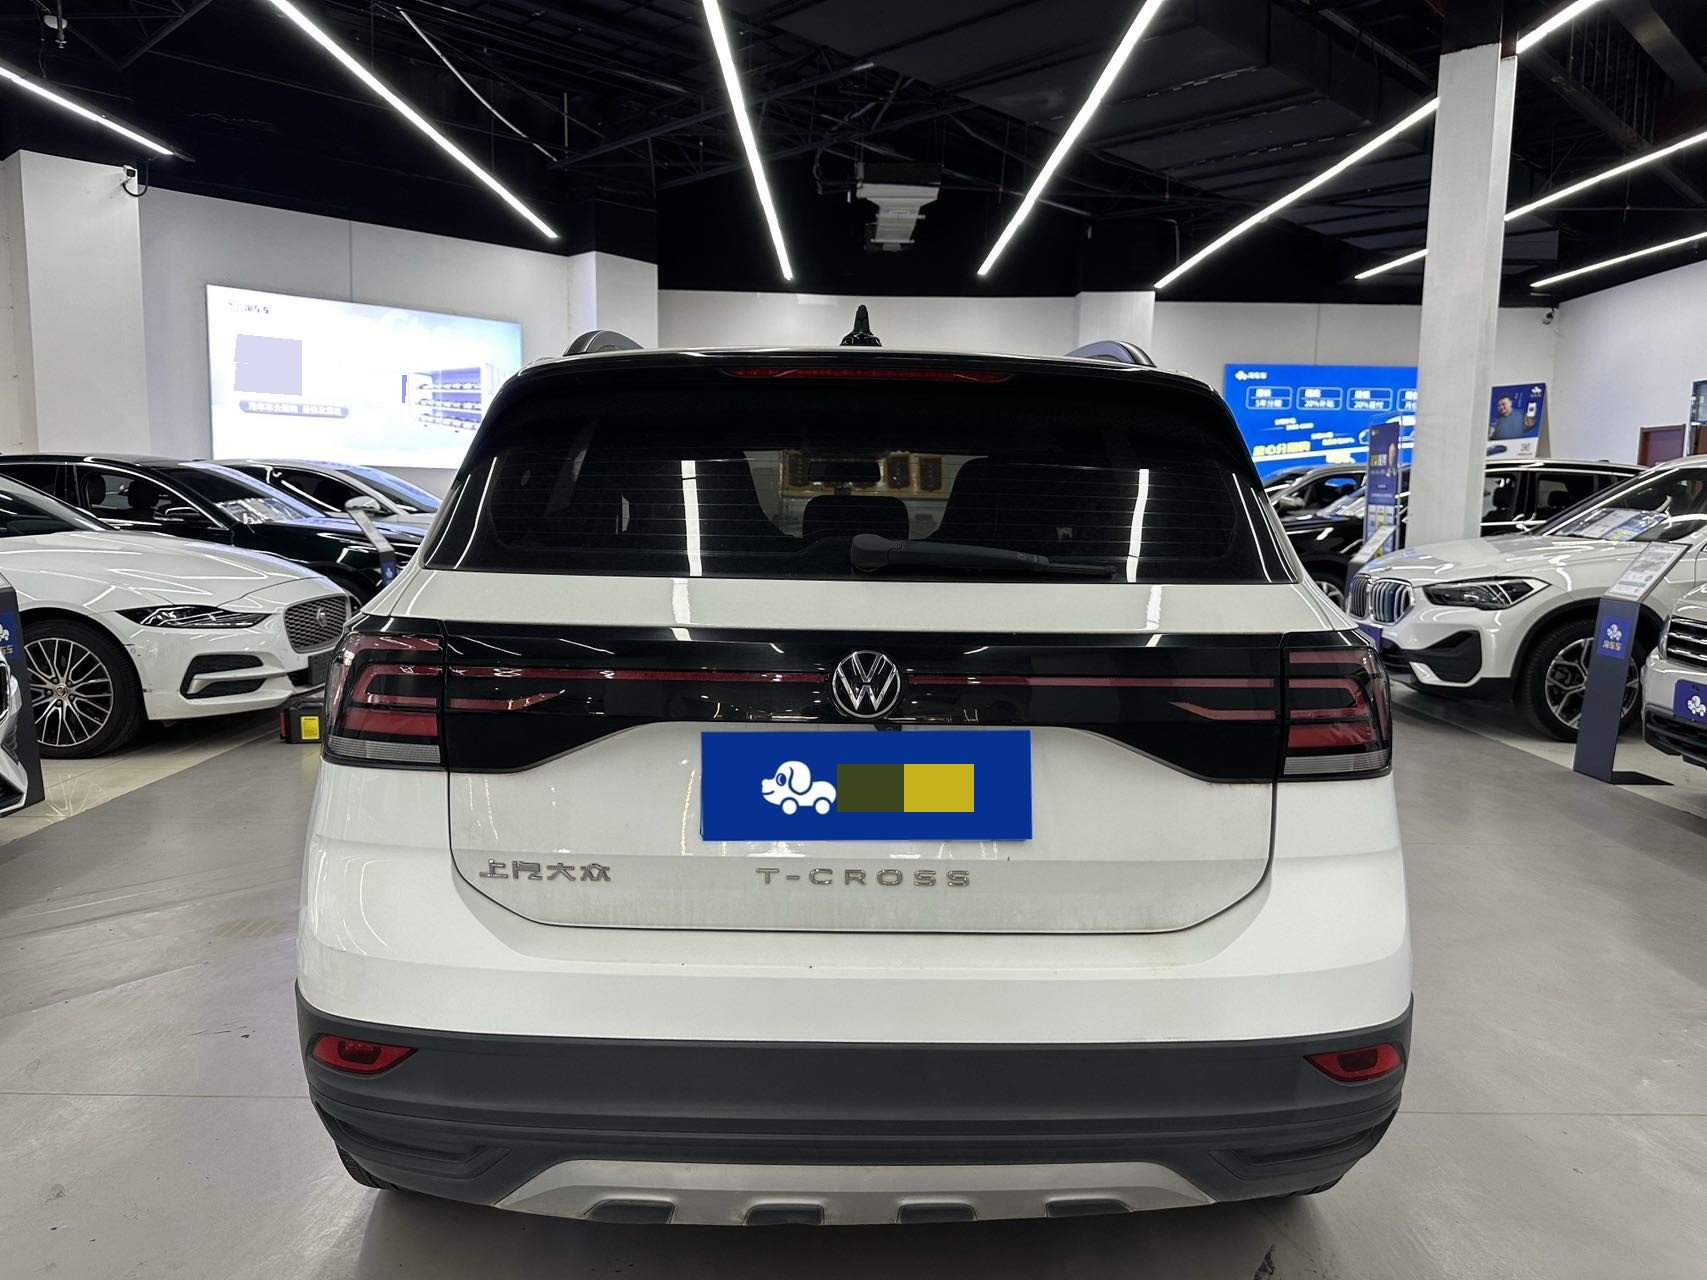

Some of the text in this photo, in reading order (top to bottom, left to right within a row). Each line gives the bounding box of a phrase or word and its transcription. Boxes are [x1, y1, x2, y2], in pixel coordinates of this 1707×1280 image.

[479, 858, 611, 881] 上汽大众
[755, 867, 972, 887] T-CROSS
